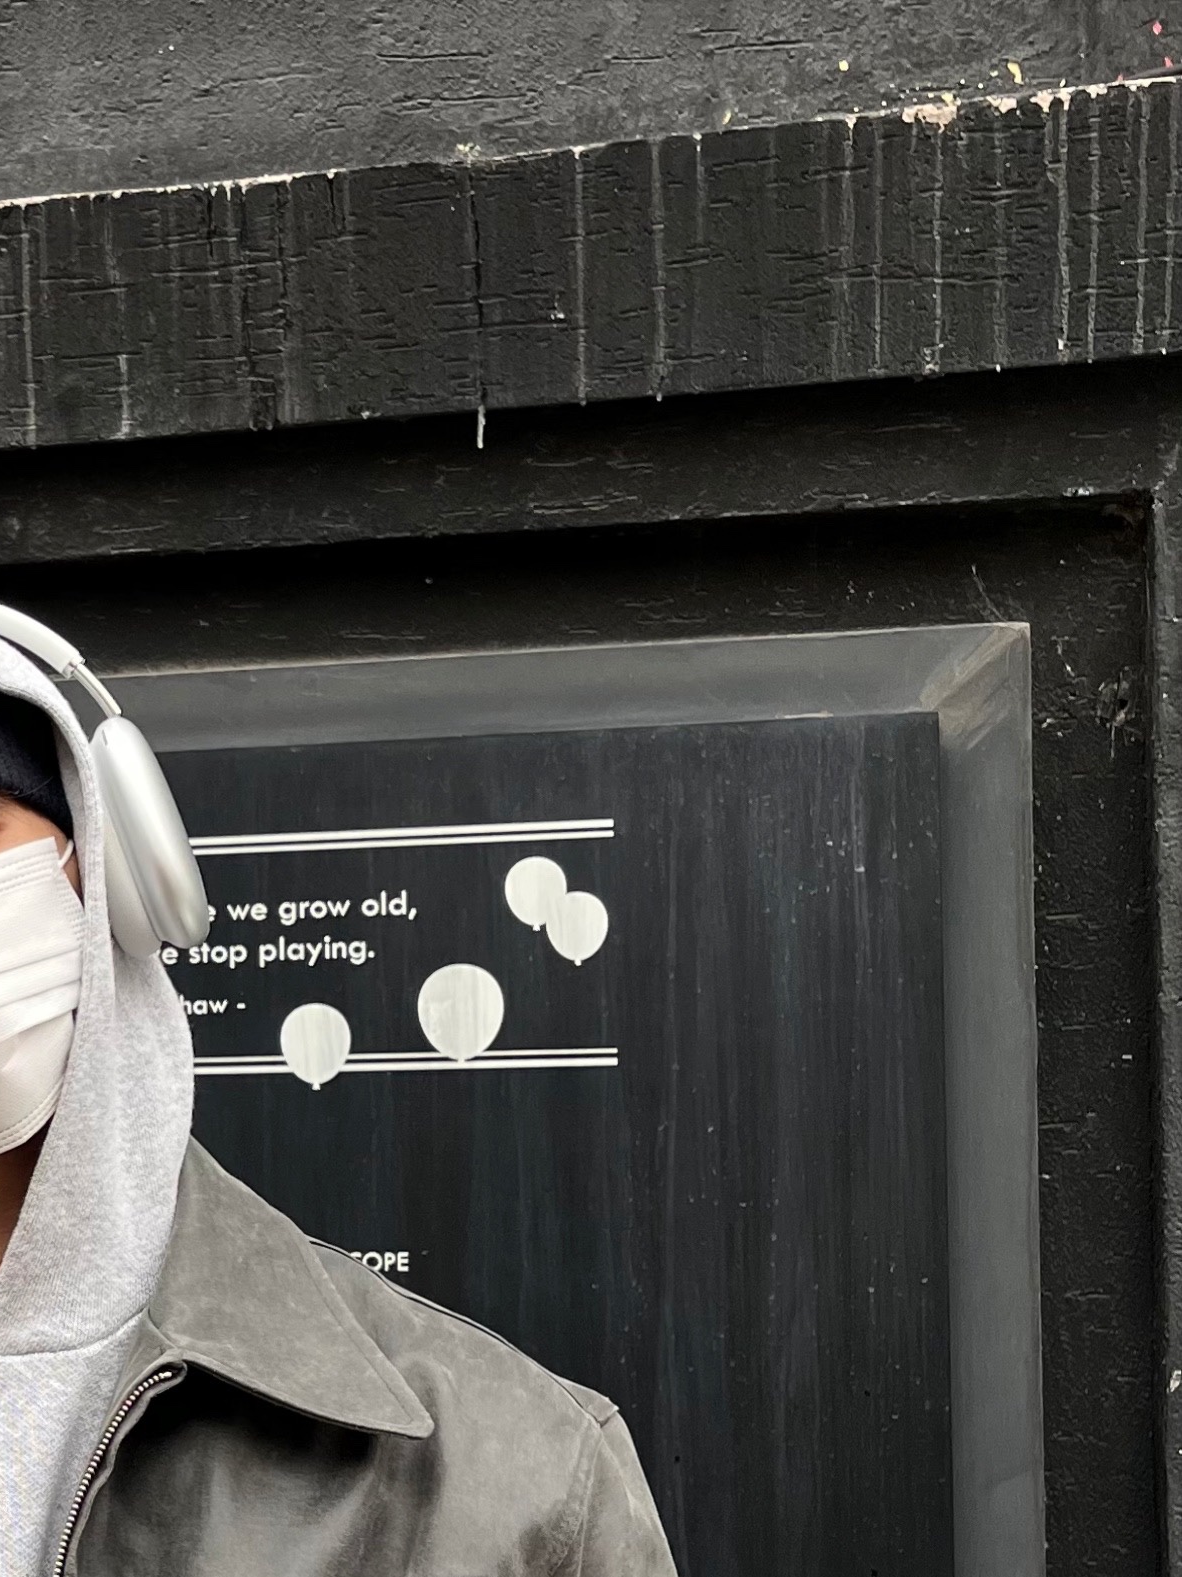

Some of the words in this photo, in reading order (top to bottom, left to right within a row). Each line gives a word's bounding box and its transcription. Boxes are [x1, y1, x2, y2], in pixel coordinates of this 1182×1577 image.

[226, 902, 268, 922] we
[278, 899, 351, 926] grow
[361, 889, 418, 921] old,
[156, 946, 178, 965] e
[188, 942, 248, 969] stop
[258, 934, 376, 968] playing.
